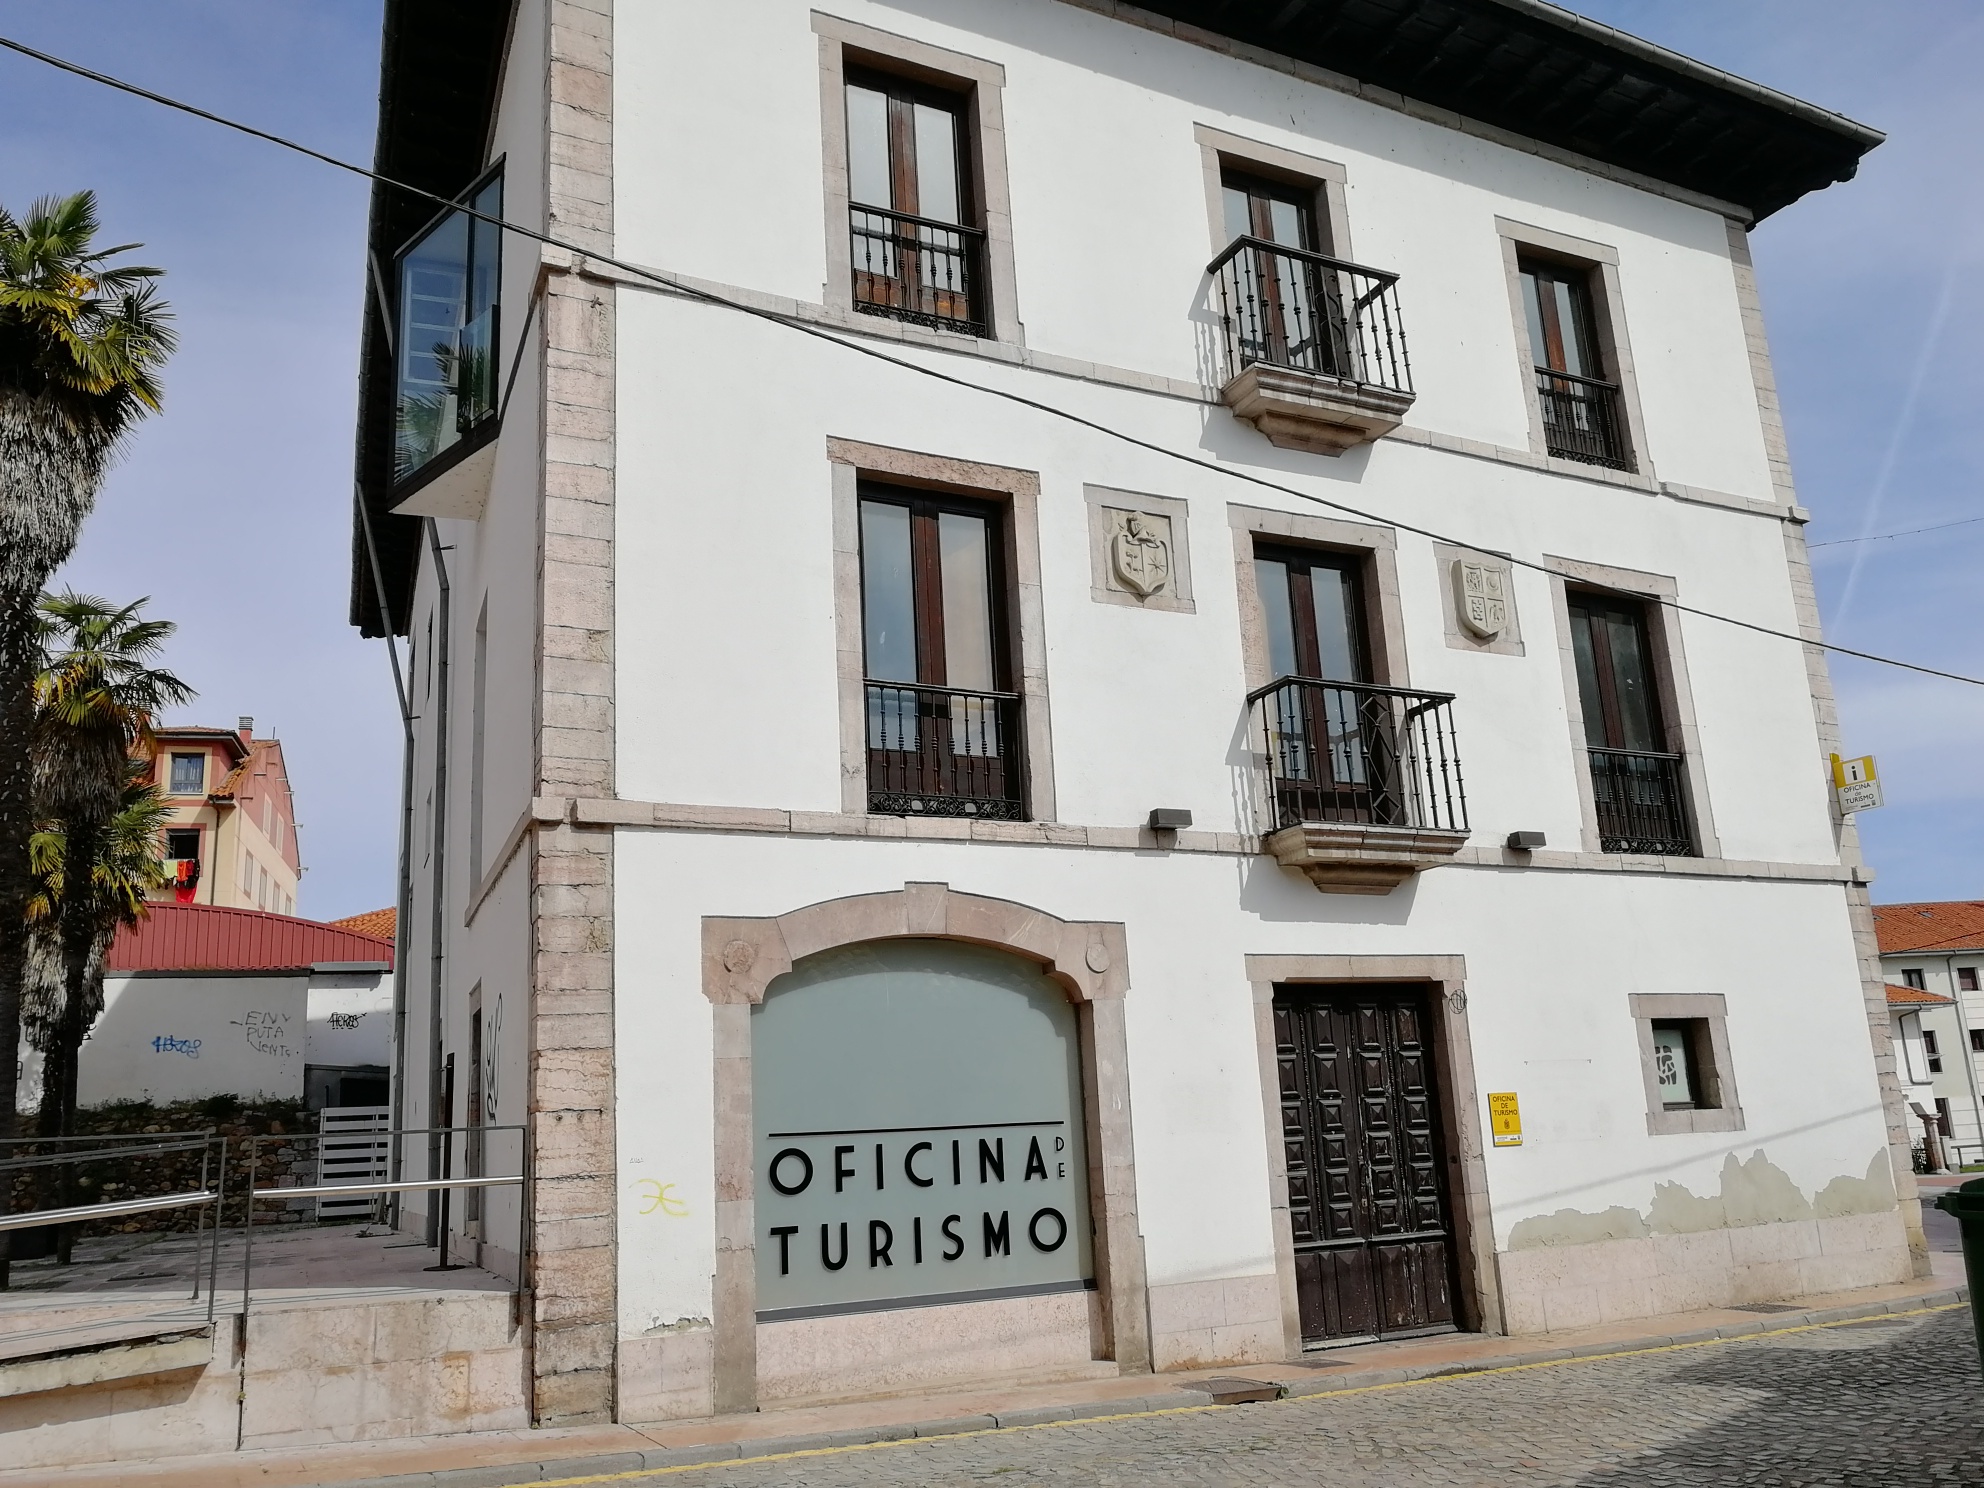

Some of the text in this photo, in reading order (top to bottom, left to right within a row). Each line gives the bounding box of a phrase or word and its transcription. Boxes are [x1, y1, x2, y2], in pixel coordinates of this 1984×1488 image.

[1844, 783, 1871, 793] OFICINA
[1845, 794, 1874, 804] TURISMO
[769, 1135, 1049, 1196] OFICINA
[769, 1206, 1068, 1276] TURISMO
